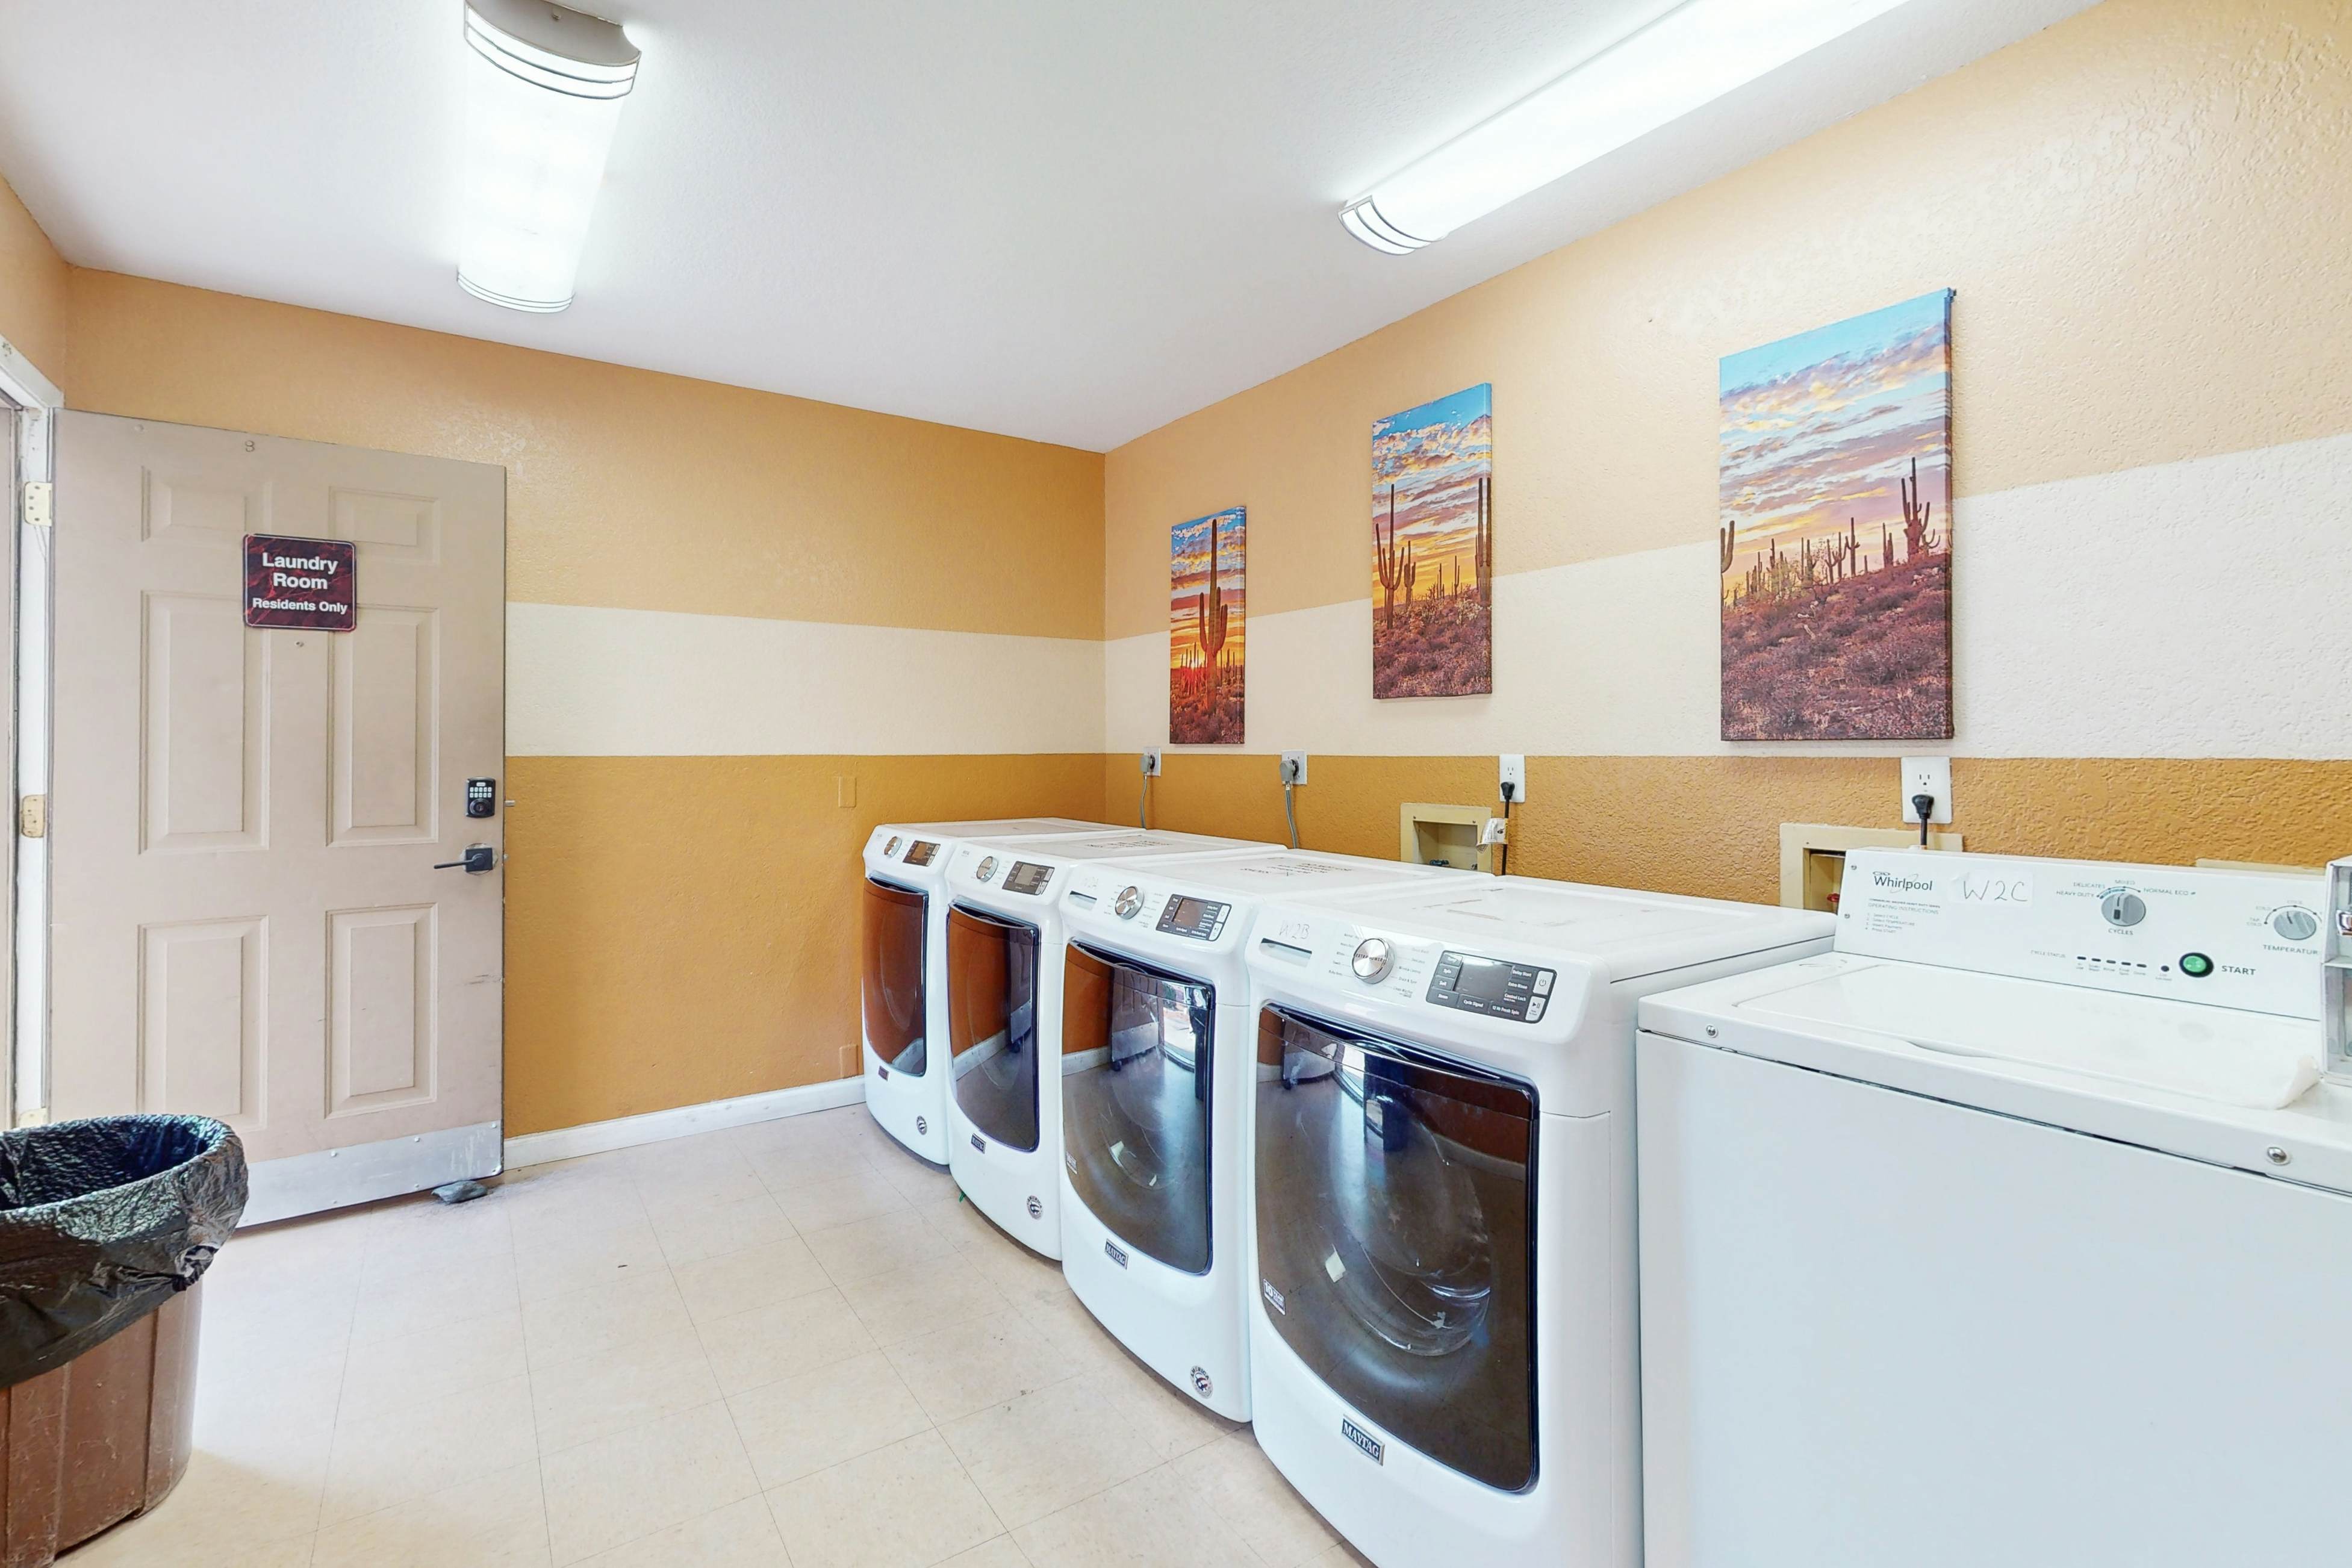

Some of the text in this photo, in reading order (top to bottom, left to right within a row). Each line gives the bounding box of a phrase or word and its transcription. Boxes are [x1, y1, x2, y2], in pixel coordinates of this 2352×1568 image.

[263, 552, 338, 574] Laundry
[273, 572, 328, 590] Room
[252, 597, 348, 615] Residents Only
[1874, 876, 1933, 891] Whirlpool
[2263, 944, 2318, 955] TEMPERATUR
[2221, 965, 2256, 975] START
[1106, 1243, 1125, 1265] MAYTAG
[1265, 1282, 1274, 1298] 10
[1343, 1422, 1380, 1458] MAYTAG
